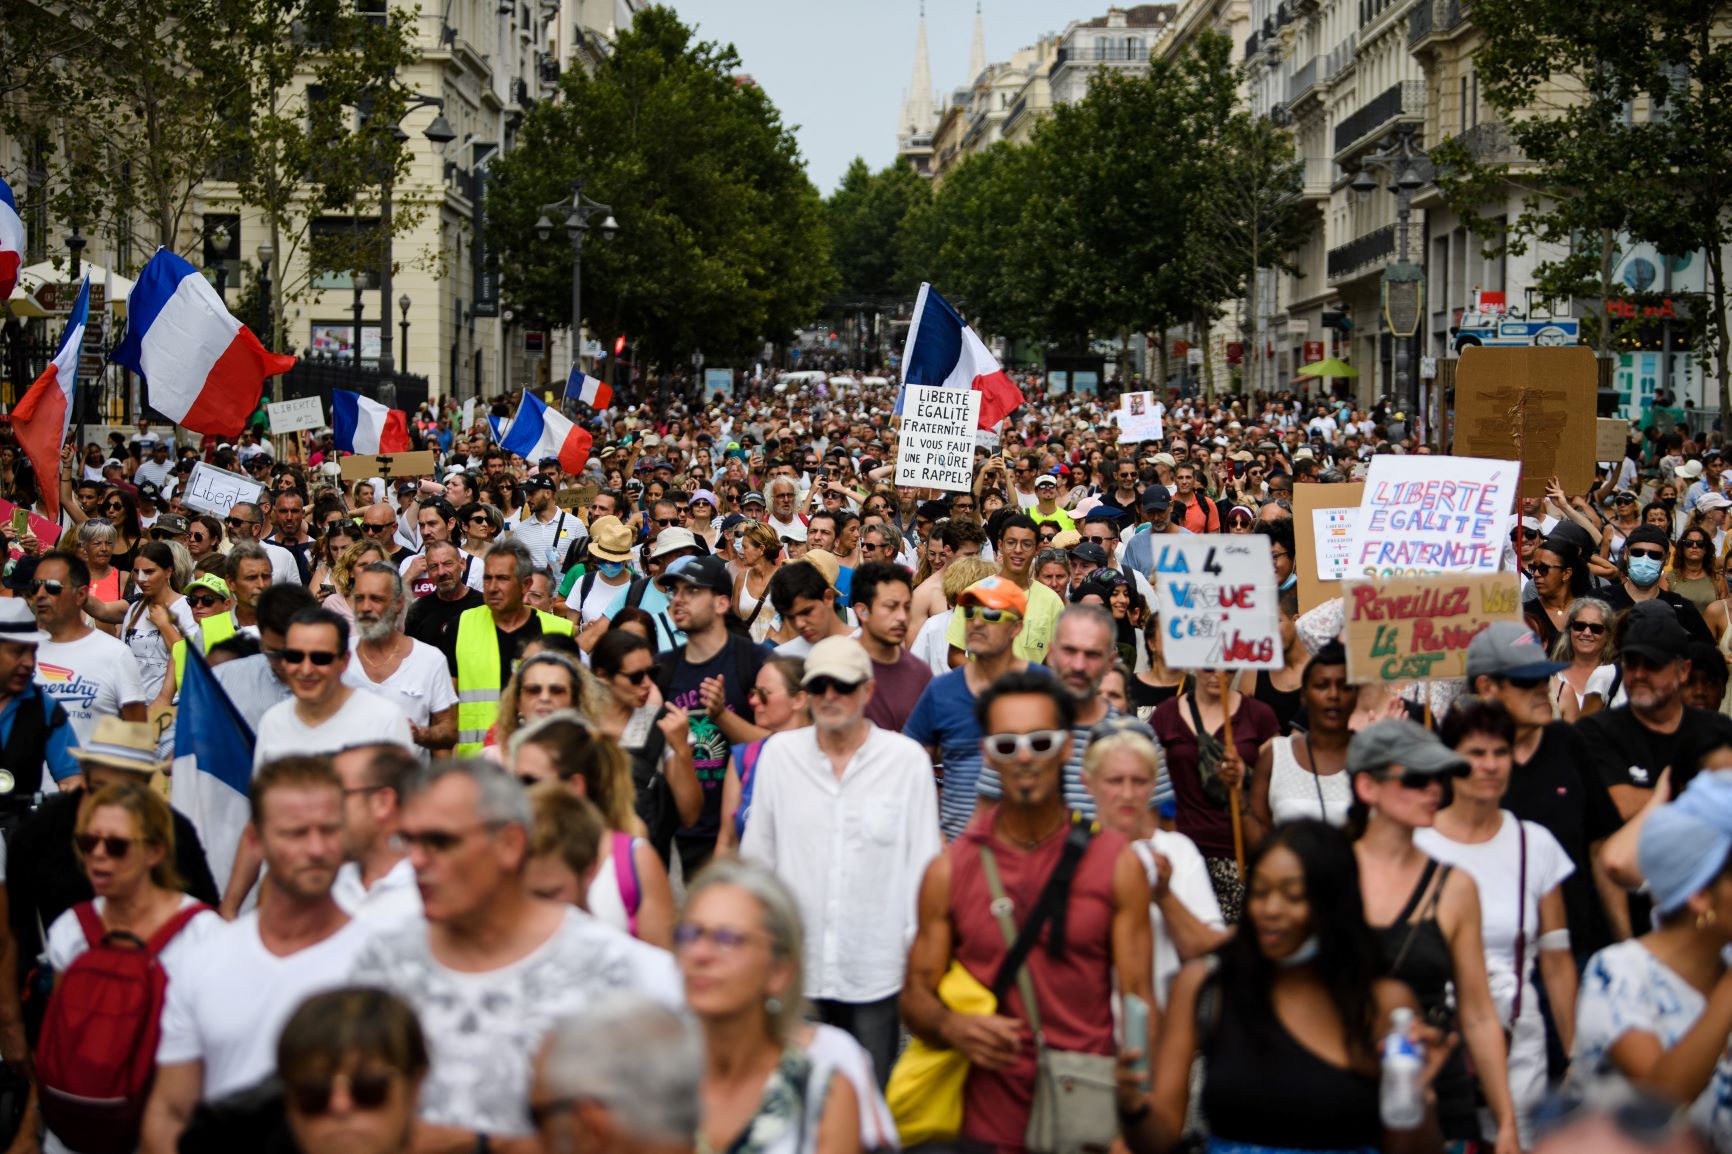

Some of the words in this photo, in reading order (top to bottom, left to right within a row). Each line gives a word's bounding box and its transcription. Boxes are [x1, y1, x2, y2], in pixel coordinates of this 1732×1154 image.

[906, 436, 914, 448] IL
[920, 439, 943, 449] VOUS
[947, 441, 971, 452] FAUT
[904, 453, 920, 463] UNE
[903, 468, 915, 478] DE
[922, 467, 972, 485] RAPPEL?
[1370, 471, 1501, 516] LIBERTÉ
[1156, 545, 1190, 574] LA
[414, 582, 437, 592] Lev
[1168, 581, 1255, 609] VAGUE
